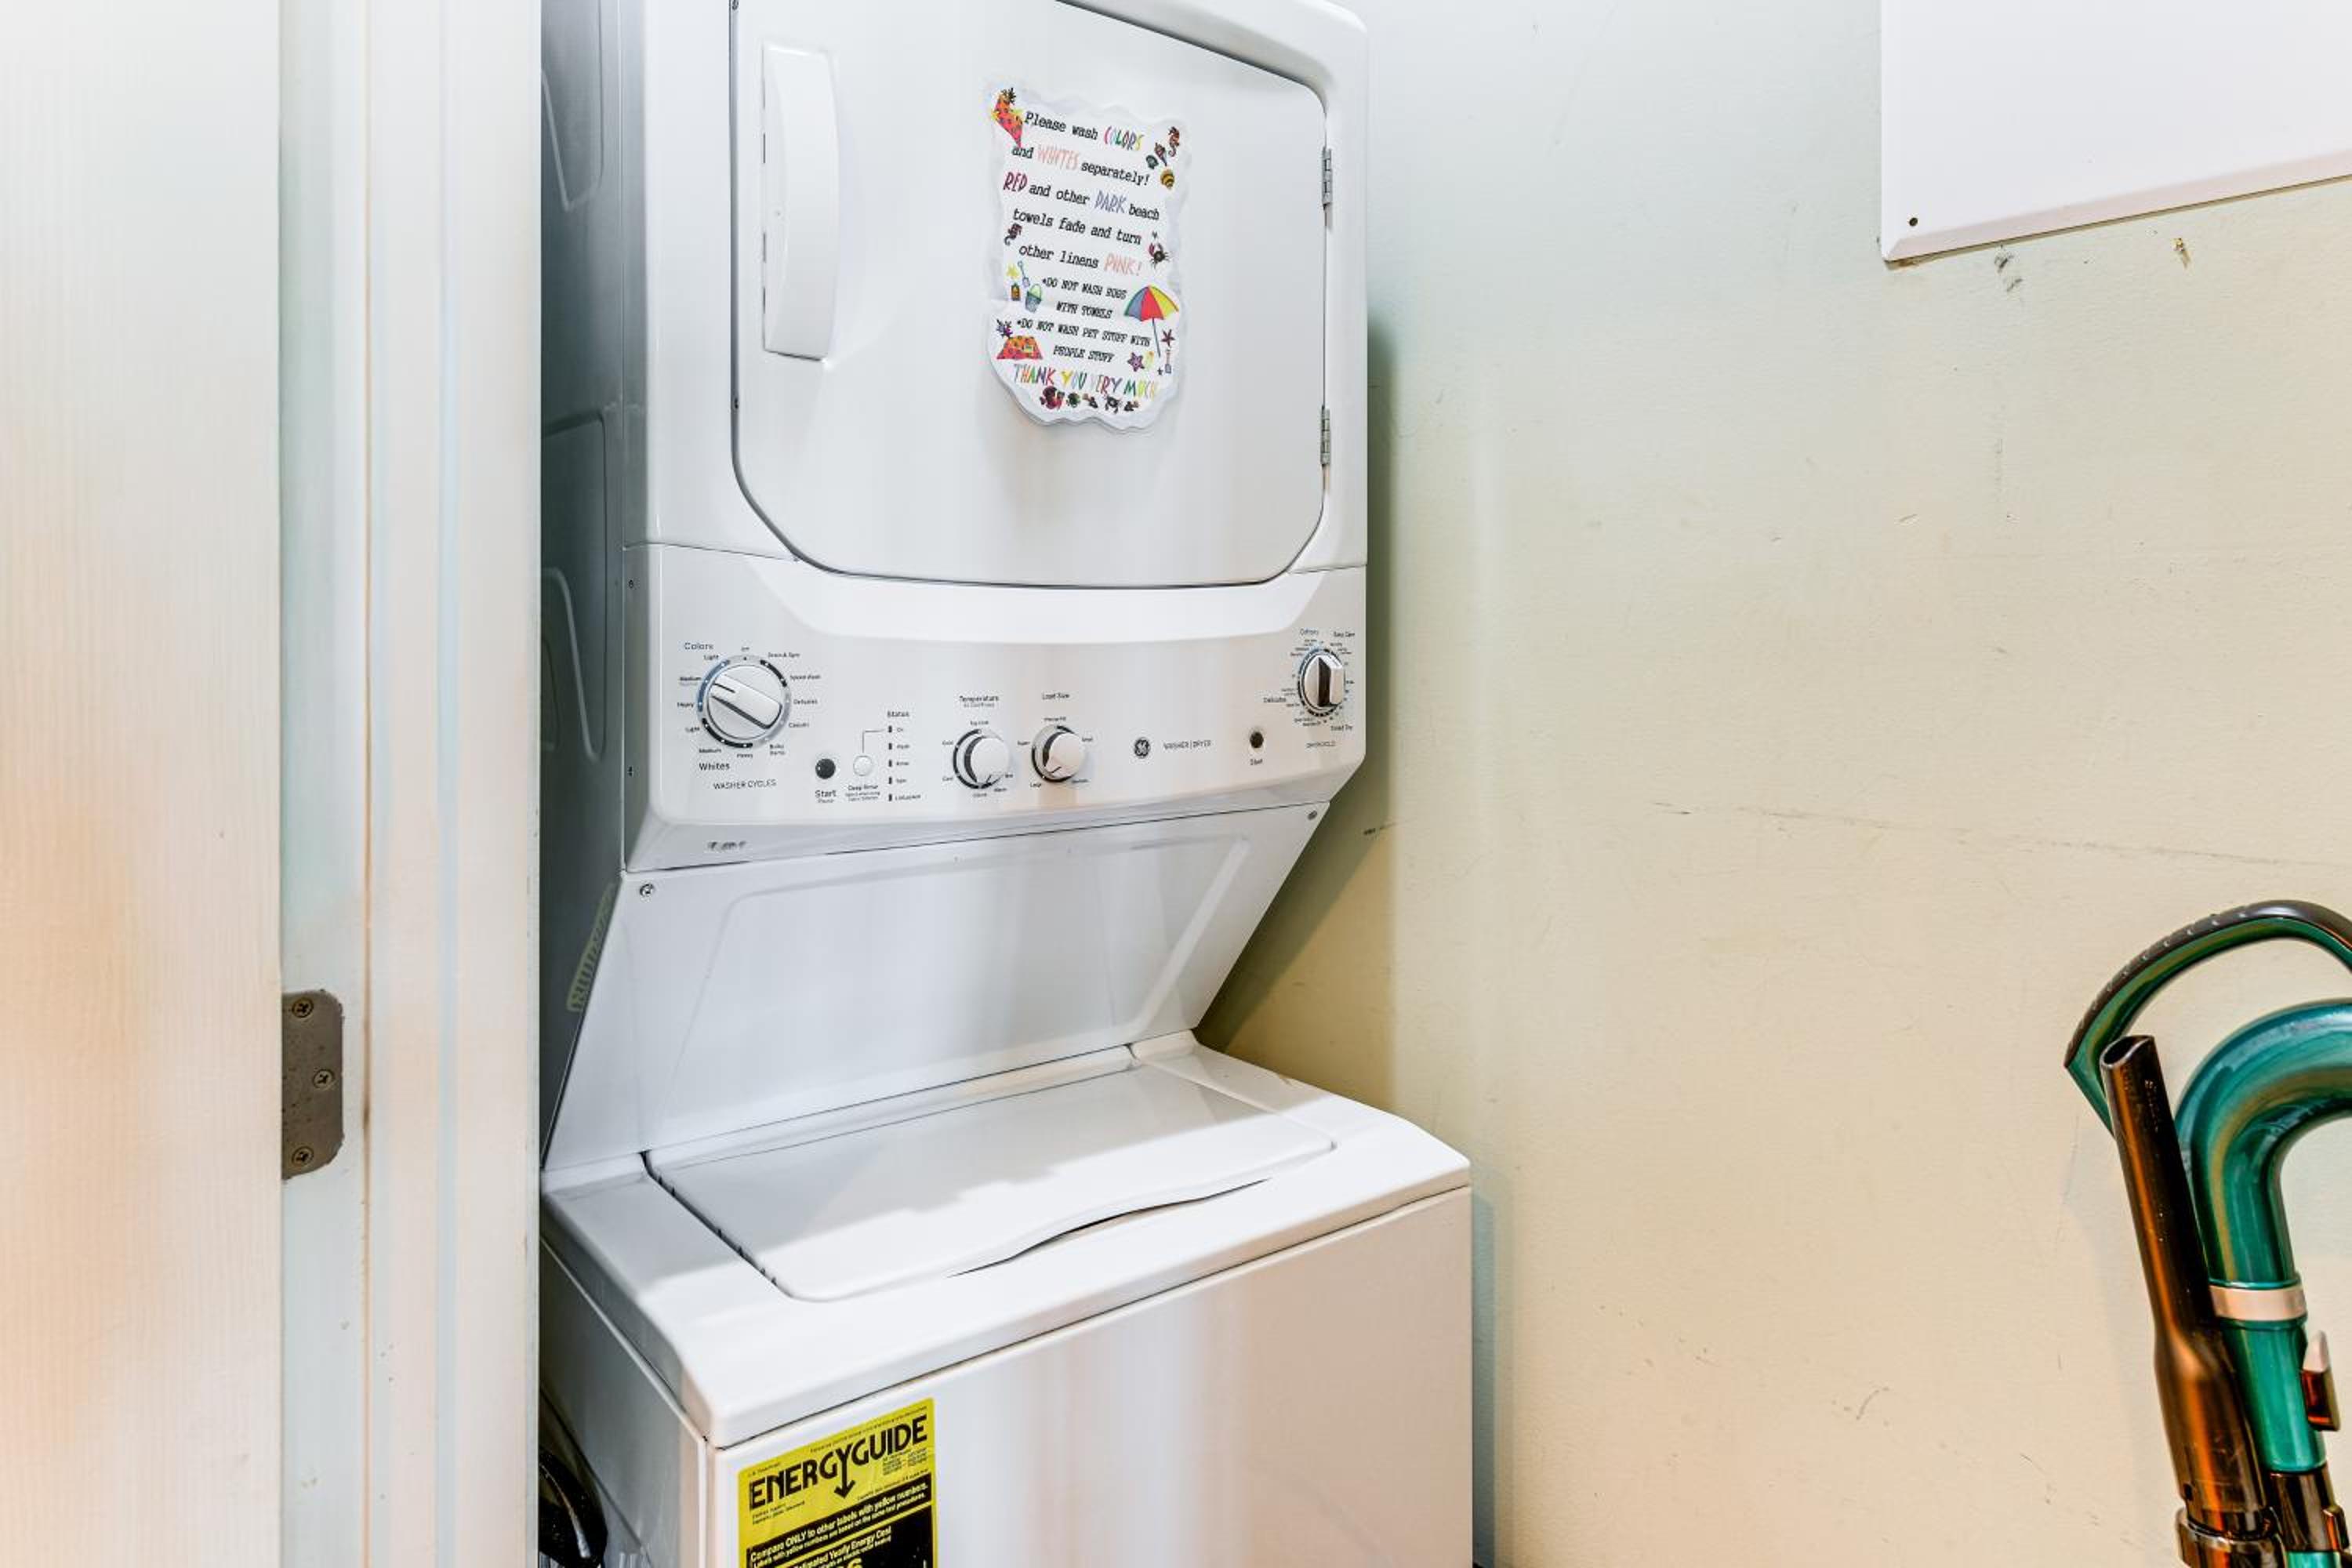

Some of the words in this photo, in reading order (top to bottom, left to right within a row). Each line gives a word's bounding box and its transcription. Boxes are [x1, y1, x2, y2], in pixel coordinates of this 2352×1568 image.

[1024, 111, 1067, 132] Please
[1072, 125, 1098, 140] wash
[1103, 125, 1145, 151] COLORS
[1011, 147, 1034, 158] and
[1037, 143, 1080, 171] WHITES
[1081, 162, 1150, 187] separately!
[1003, 171, 1028, 193] RED
[1029, 183, 1051, 198] and
[1056, 189, 1090, 205] other
[1094, 191, 1127, 214] DARK
[1128, 204, 1160, 220] beach
[1013, 208, 1054, 227] towels
[1058, 218, 1086, 234] fade
[1091, 225, 1111, 239] and
[1116, 229, 1142, 245] turn
[1019, 243, 1054, 261] other
[1060, 250, 1099, 269] linens
[1104, 253, 1142, 277] PINK!
[1061, 280, 1079, 291] NOT
[1082, 283, 1103, 296] WASH
[1056, 301, 1079, 314] WITH
[1081, 305, 1112, 319] TOWELS
[1036, 320, 1054, 332] NOT
[1058, 323, 1079, 336] WASH
[1082, 325, 1098, 339] PET
[1102, 330, 1127, 343] STUFF
[1130, 334, 1151, 347] WITH
[1053, 344, 1085, 359] PEOPLE
[1087, 350, 1115, 363] STUFF
[1014, 363, 1056, 385] THANK
[1060, 369, 1087, 390] YOU
[1090, 374, 1123, 395] VERY
[684, 642, 714, 651] Colors
[959, 695, 1000, 703] Temperature
[1163, 741, 1189, 750] WASHER
[1192, 739, 1212, 748] DRYER
[699, 762, 731, 771] Whites
[713, 781, 746, 790] WASHER
[748, 779, 777, 788] CYCLES
[815, 789, 837, 798] Start
[750, 1414, 927, 1510] ENERGYGUIDE
[750, 1541, 785, 1563] Compare
[785, 1530, 807, 1548] ONLY
[807, 1528, 816, 1538] to
[816, 1520, 837, 1534] other
[837, 1511, 858, 1526] labels
[858, 1503, 874, 1517] with
[874, 1495, 896, 1512] yellow
[896, 1483, 928, 1501] numbers.
[829, 1544, 851, 1560] Yearly
[851, 1534, 875, 1551] Energy
[876, 1525, 891, 1539] Cost
